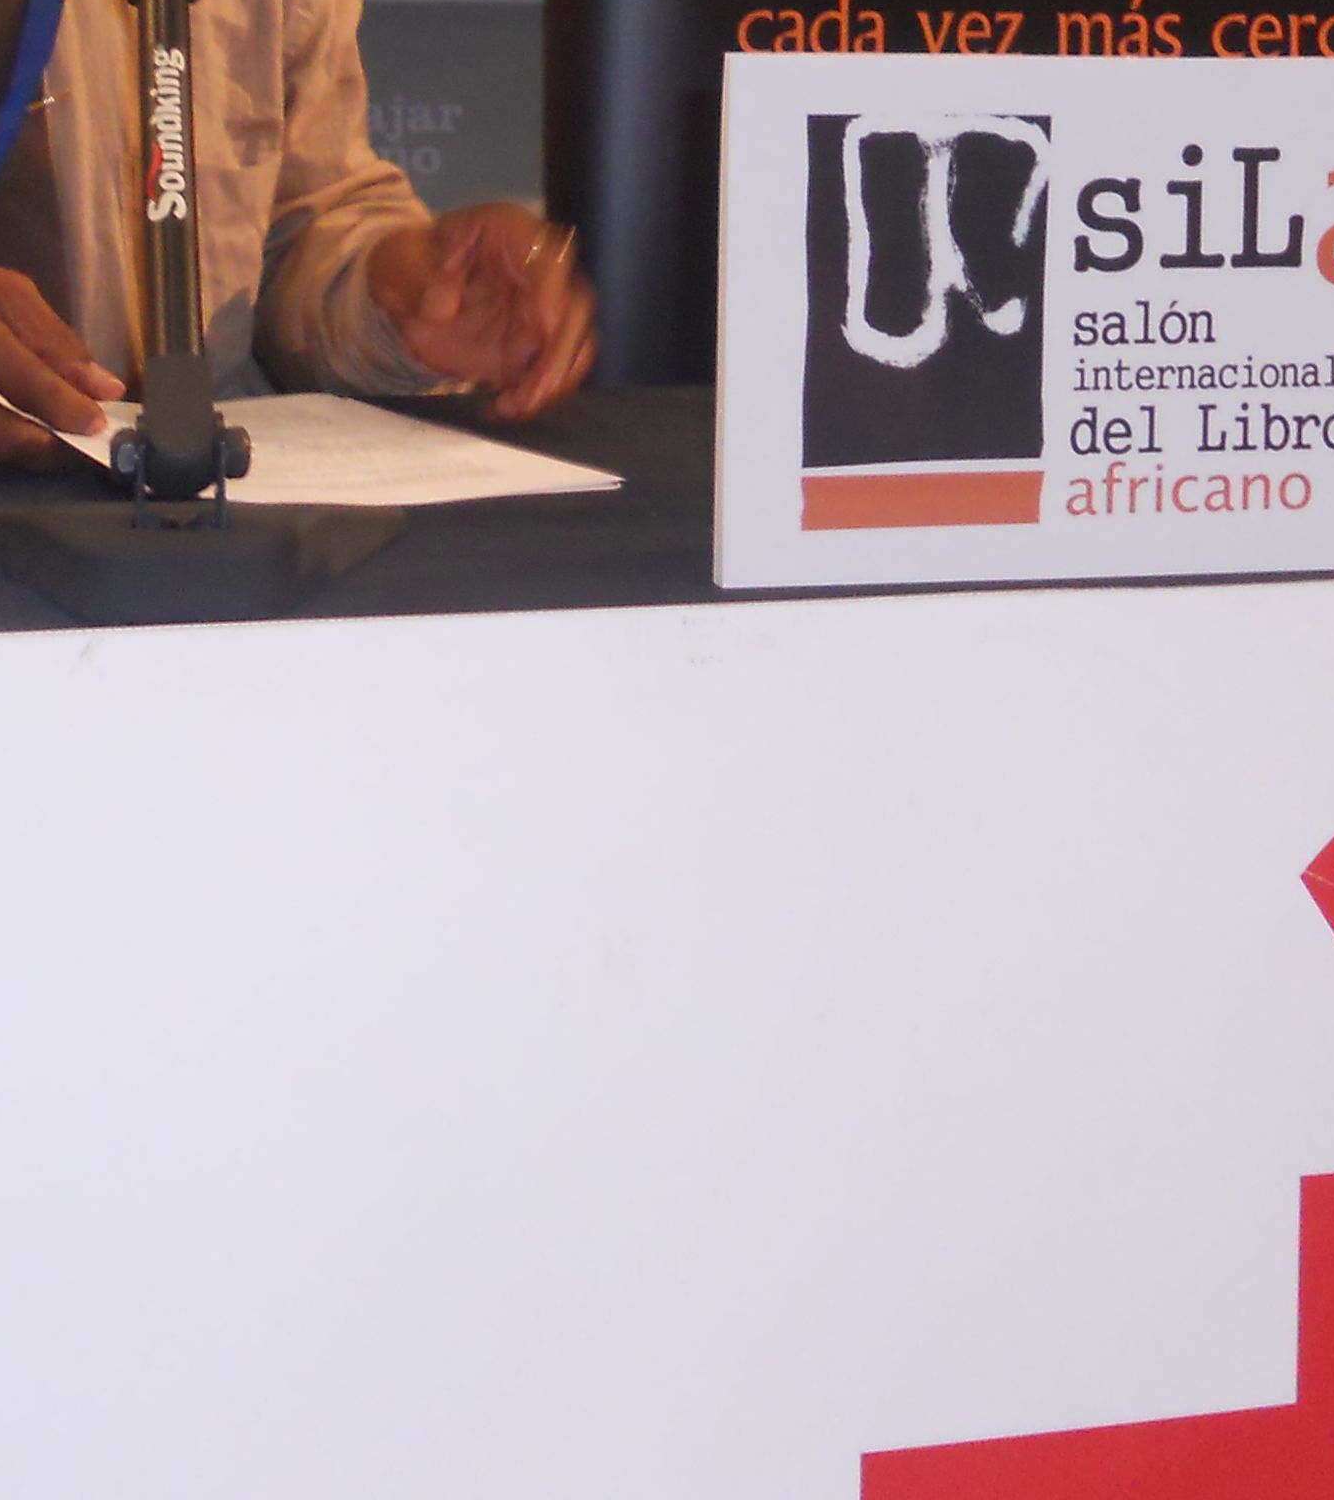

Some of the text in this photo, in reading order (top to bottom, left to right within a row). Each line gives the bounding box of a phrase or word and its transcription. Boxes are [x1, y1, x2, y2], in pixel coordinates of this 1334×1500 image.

[915, 10, 1024, 55] vez
[147, 46, 186, 223] Soundking
[1073, 300, 1217, 347] salón
[1070, 407, 1163, 455] del
[1066, 461, 1313, 517] africano
